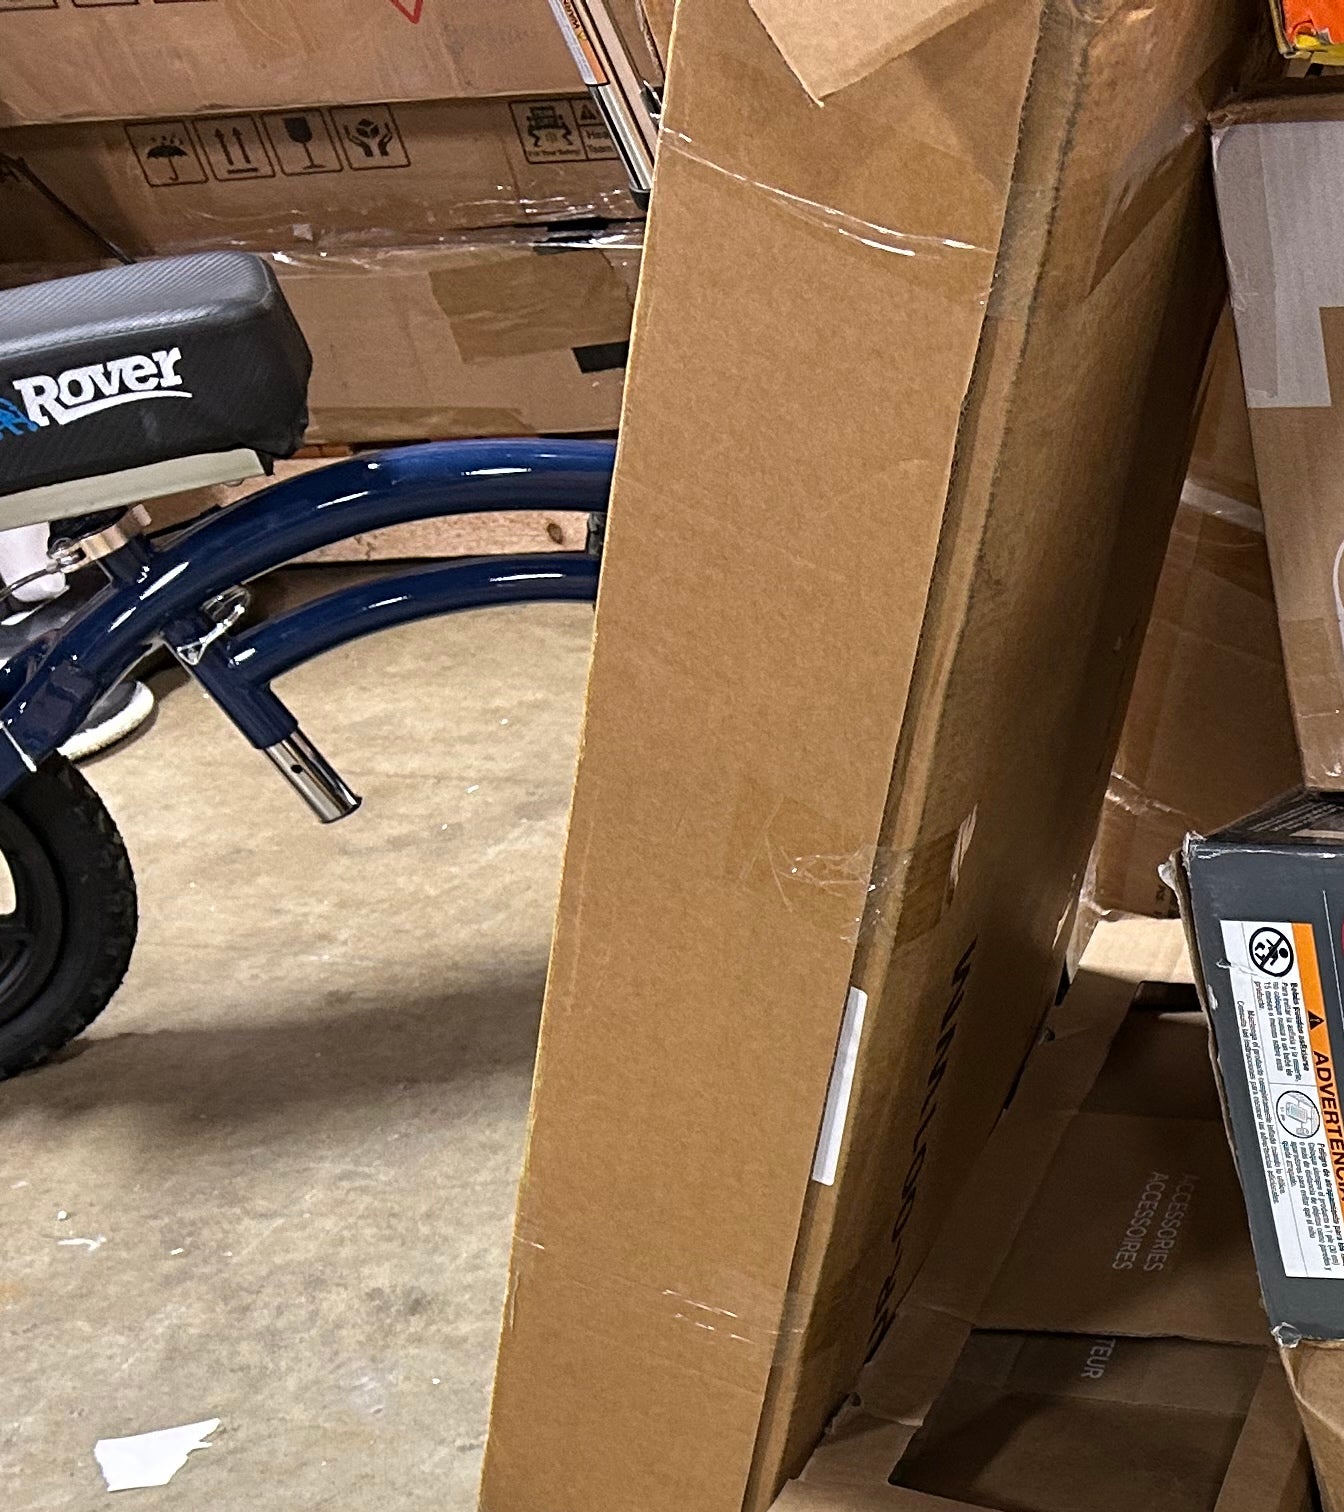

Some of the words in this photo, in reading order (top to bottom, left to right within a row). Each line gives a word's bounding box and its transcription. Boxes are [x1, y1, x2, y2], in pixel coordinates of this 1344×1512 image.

[12, 347, 192, 426] Rover
[1112, 1170, 1168, 1270] ACCESSOIRES
[1143, 1172, 1197, 1273] ACCESSORIES
